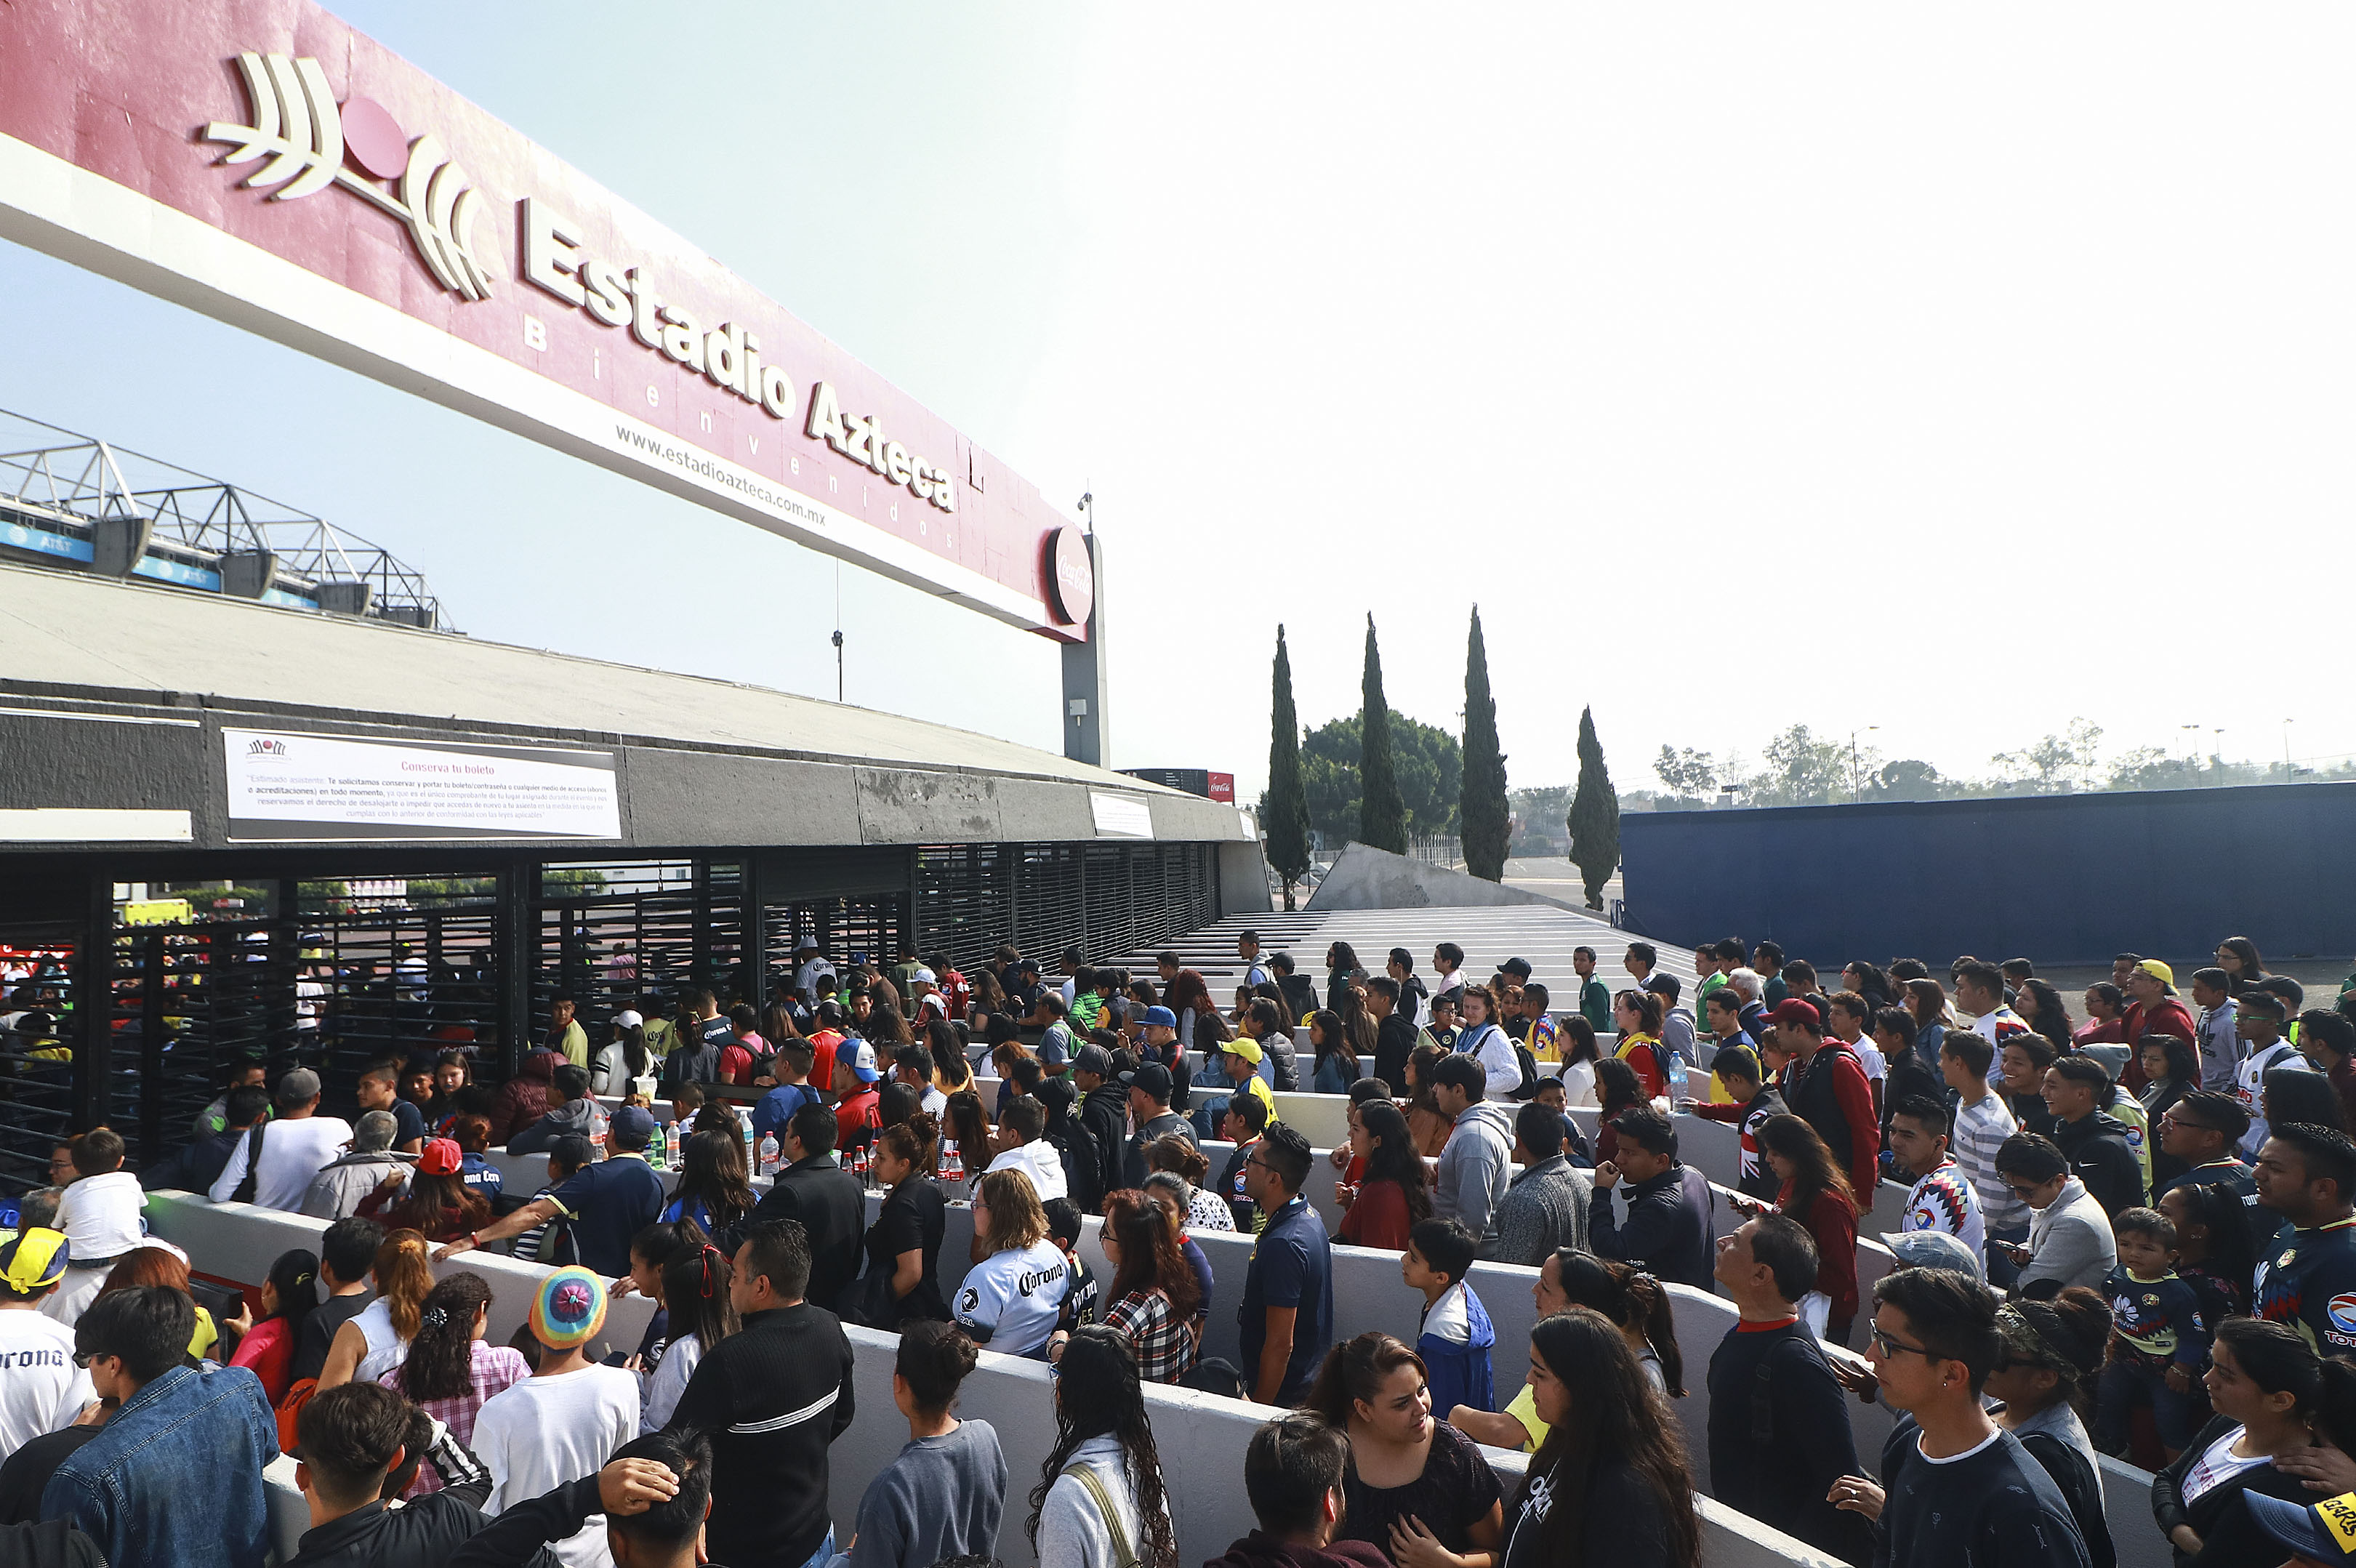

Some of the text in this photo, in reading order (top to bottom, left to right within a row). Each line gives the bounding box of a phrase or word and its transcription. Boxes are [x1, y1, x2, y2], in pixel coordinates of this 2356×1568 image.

[523, 197, 954, 512] Estadio Azteca
[523, 313, 953, 549] Bienvenidos
[616, 425, 826, 526] www.estadioazteca.com.mx
[40, 536, 72, 552] AT&T
[401, 761, 494, 774] Conserva tu boleto
[338, 777, 379, 786] solicitamos
[452, 781, 507, 790] boleto/contraseña
[704, 1028, 727, 1040] Corona
[464, 1173, 481, 1183] ona
[1019, 1263, 1064, 1298] Corona
[2115, 1318, 2139, 1332] AWEI
[0, 1350, 63, 1369] rona
